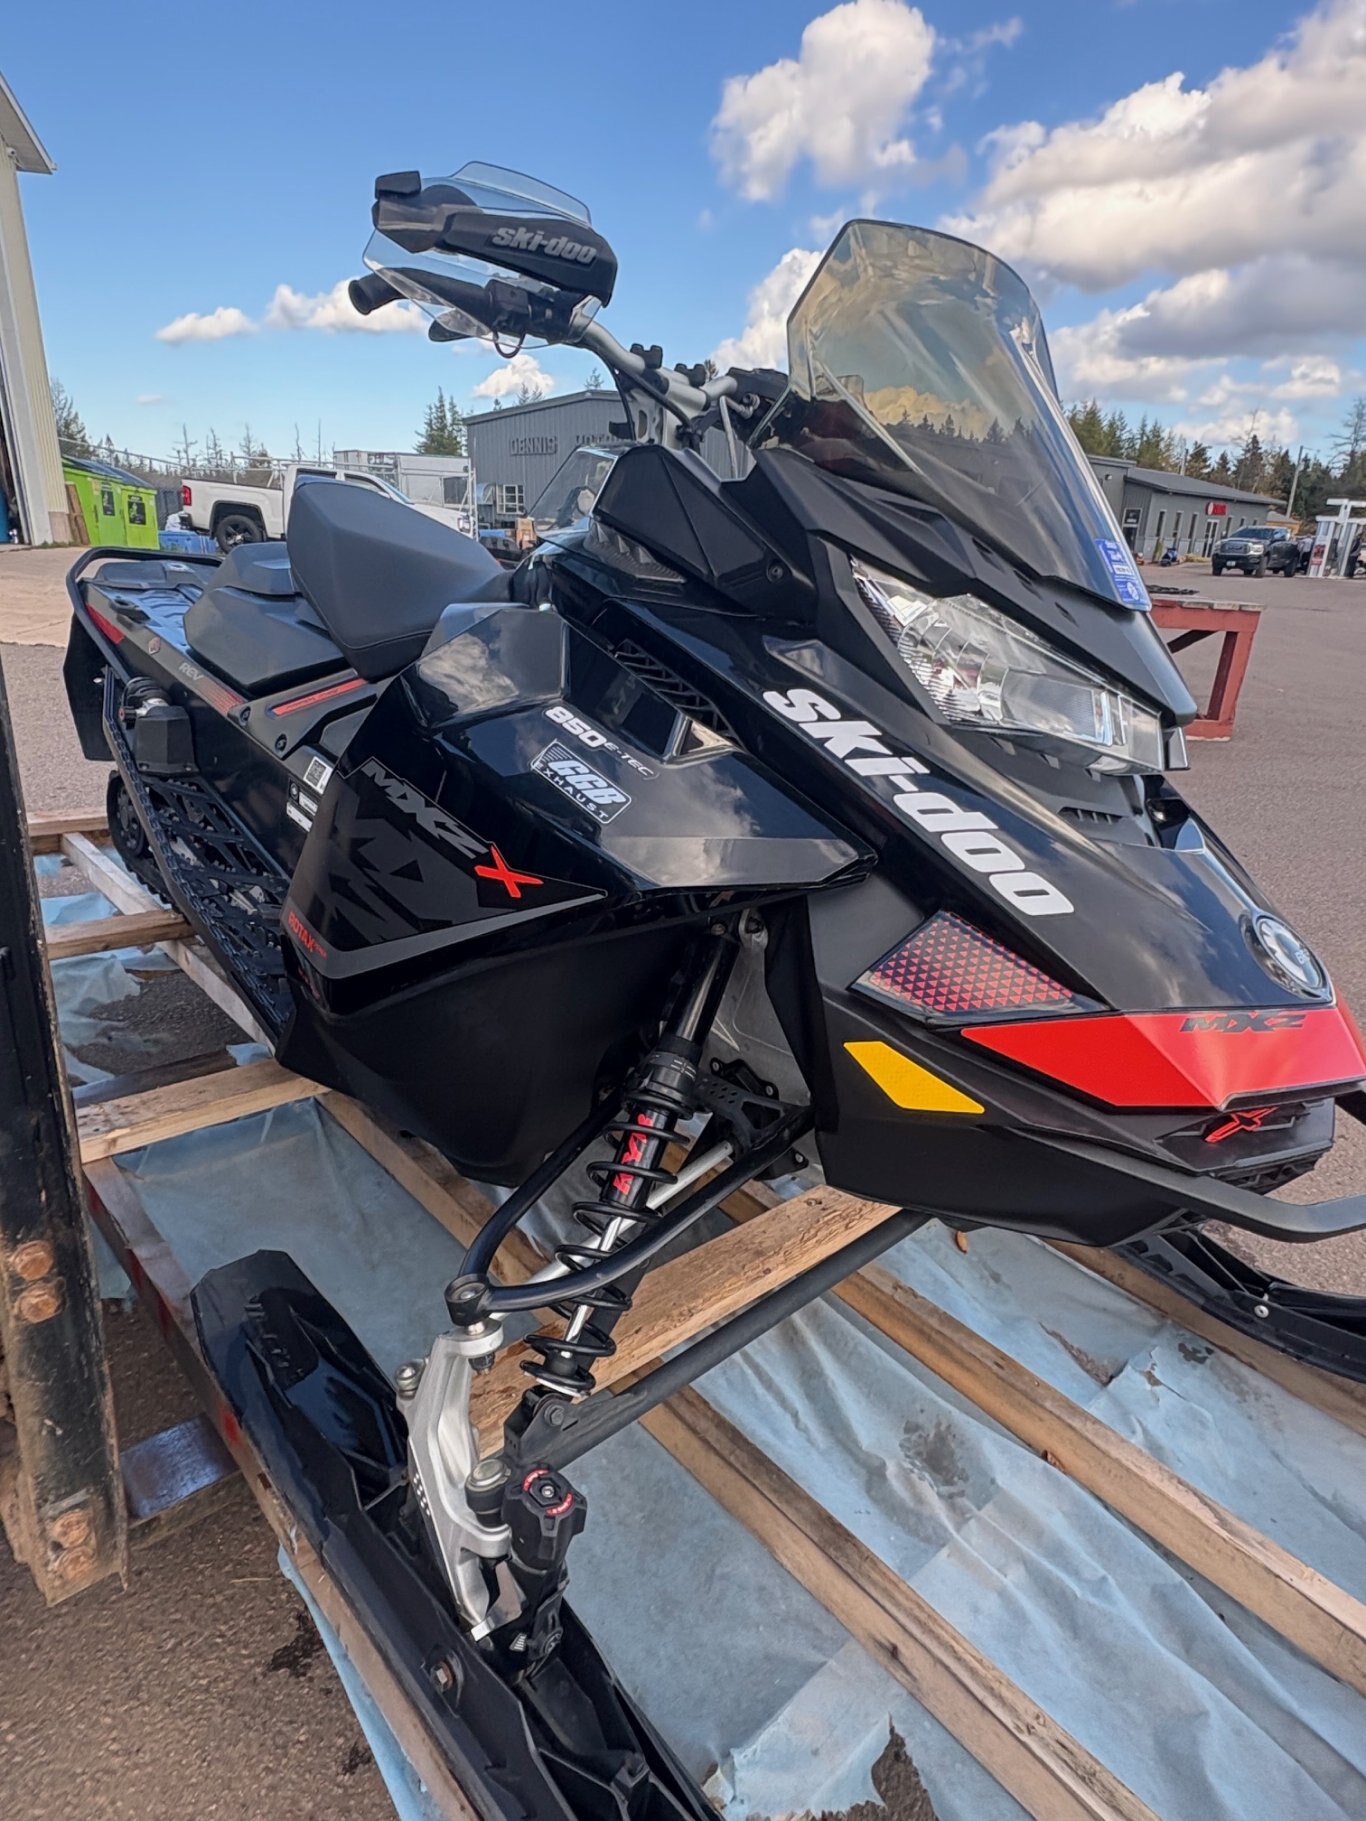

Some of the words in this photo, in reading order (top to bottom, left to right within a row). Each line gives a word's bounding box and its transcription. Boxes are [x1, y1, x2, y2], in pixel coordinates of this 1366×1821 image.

[492, 227, 597, 264] ski-doo
[510, 437, 557, 456] DENNIS
[178, 662, 204, 681] REV
[545, 706, 607, 748] 850
[604, 741, 654, 776] E-TEC
[533, 762, 609, 819] EXHAUST
[762, 688, 1075, 916] ski-doo
[474, 845, 544, 898] X
[288, 911, 316, 953] ROTAX
